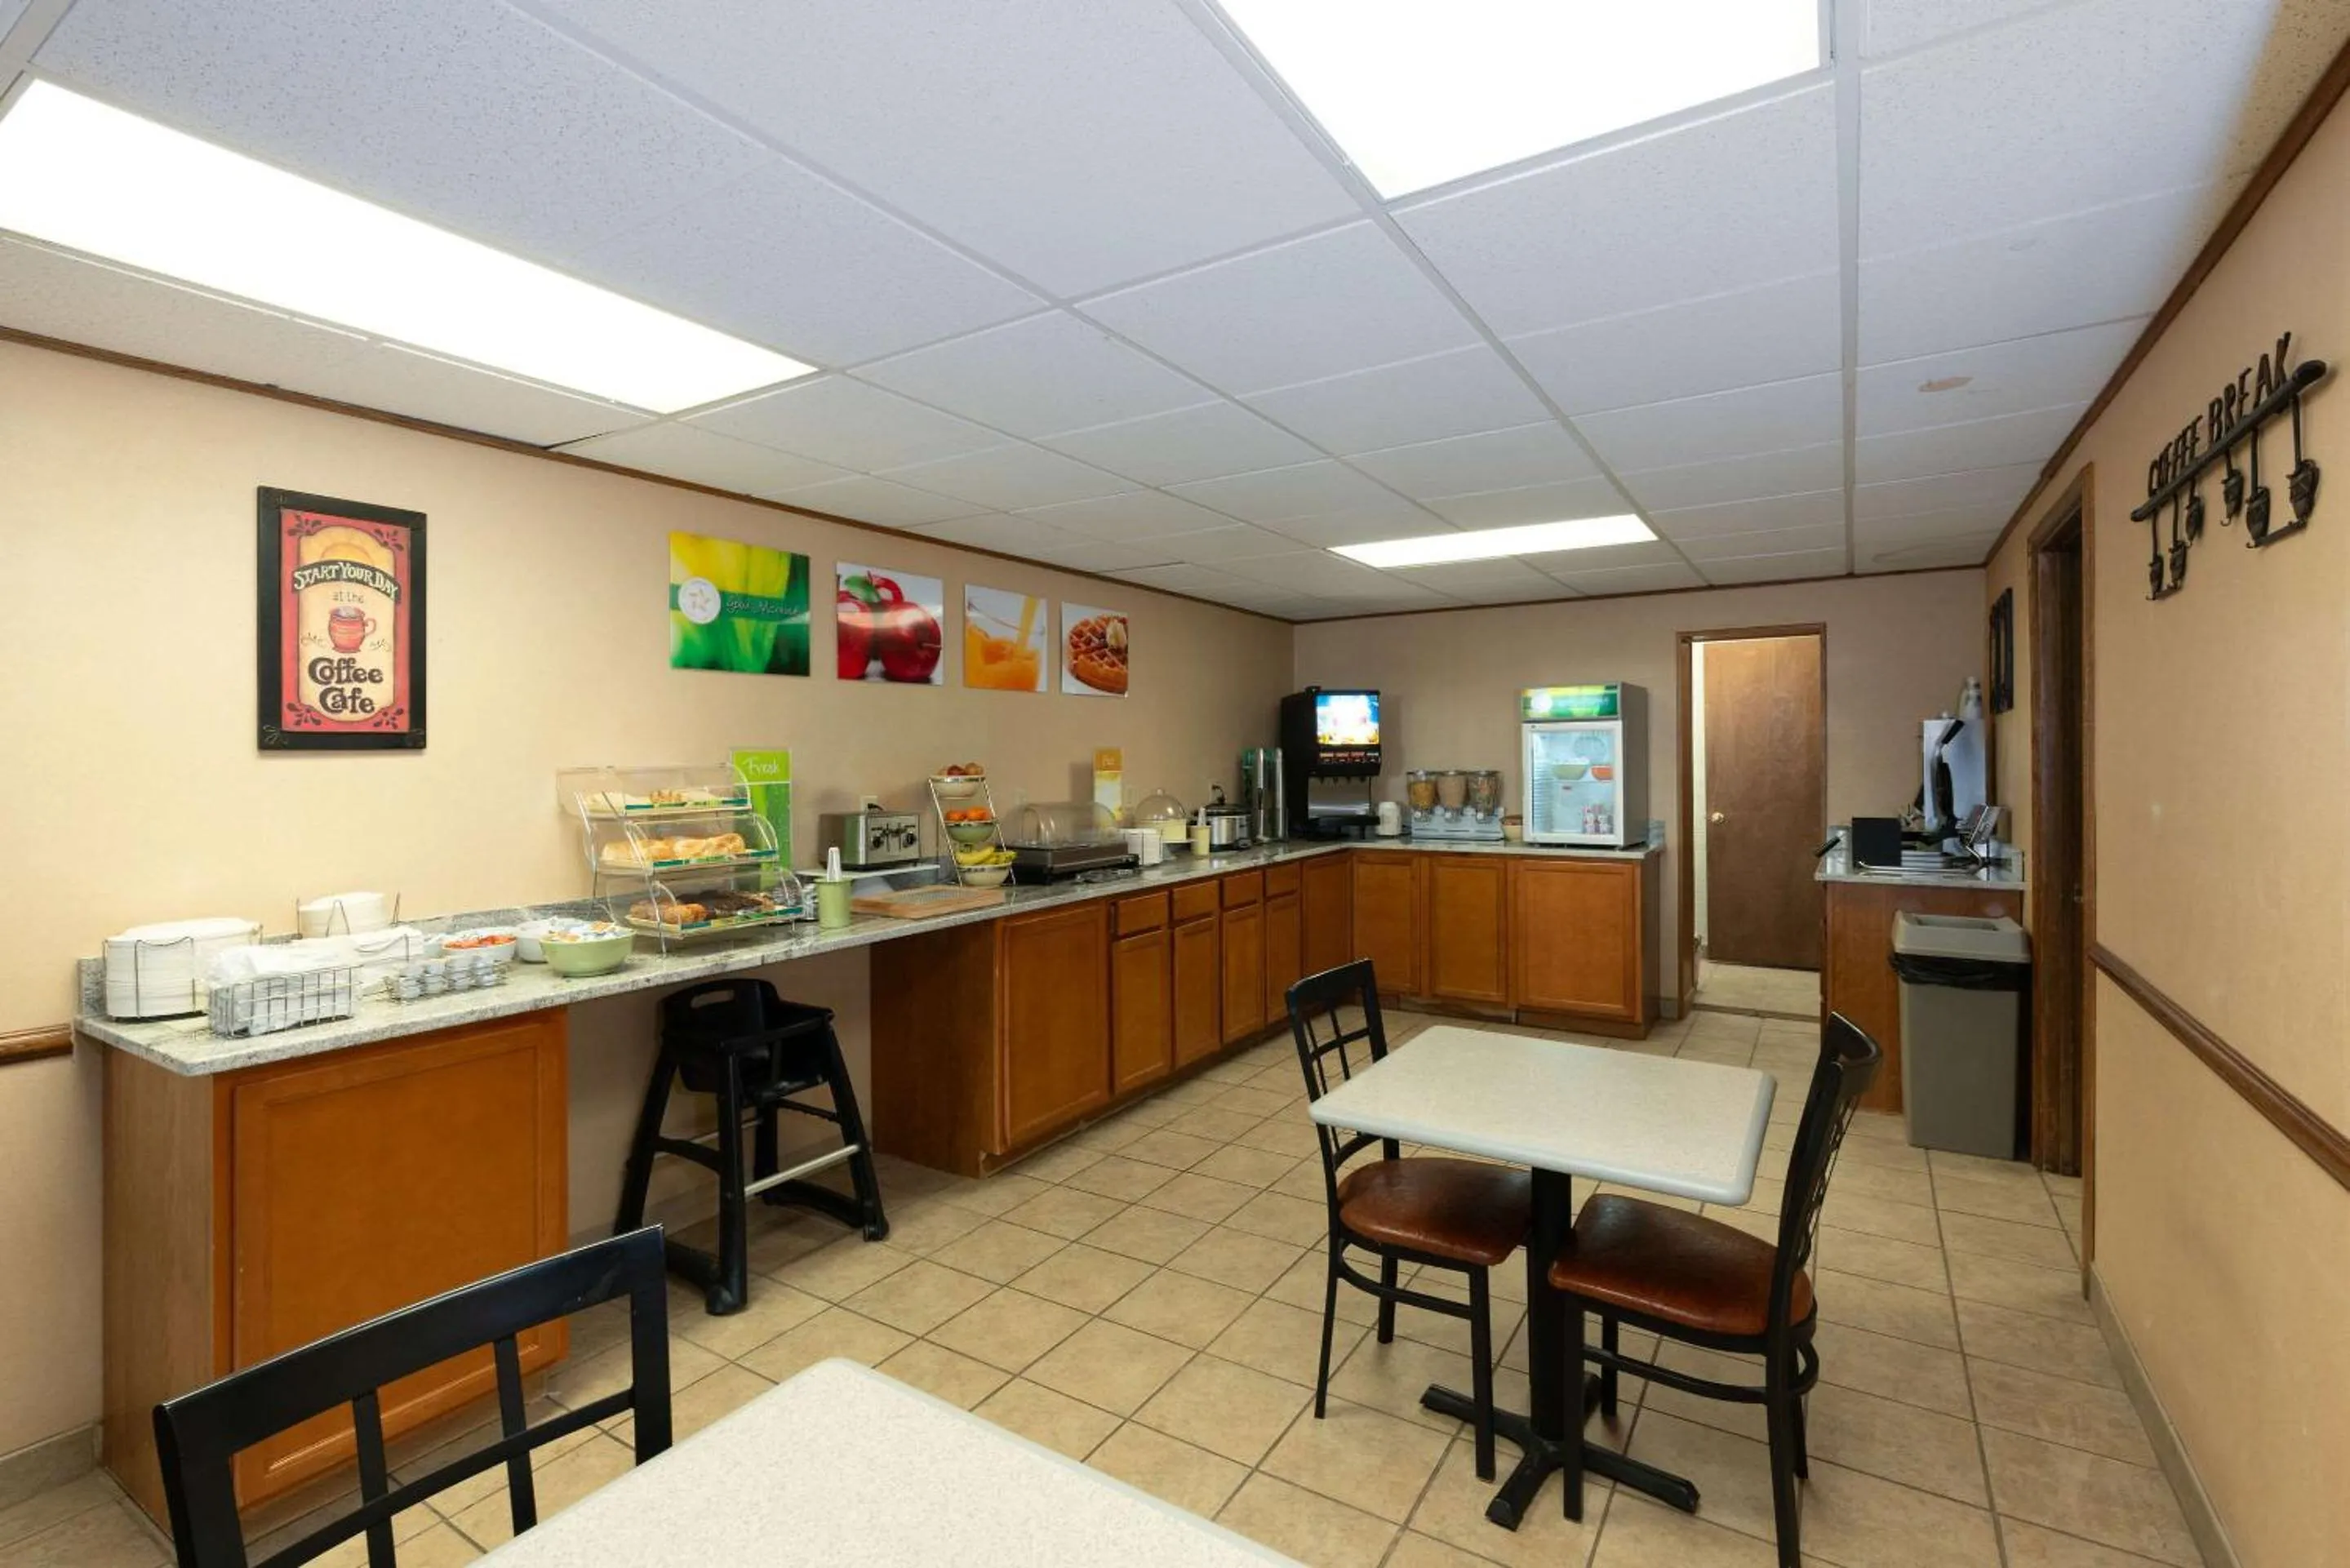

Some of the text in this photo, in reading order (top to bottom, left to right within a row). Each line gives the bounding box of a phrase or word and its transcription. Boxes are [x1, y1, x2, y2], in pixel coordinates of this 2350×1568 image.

[2207, 331, 2291, 450] BREAK
[294, 562, 398, 600] START YOUR DAY
[308, 656, 384, 686] Coffee
[319, 686, 375, 714] Cafe
